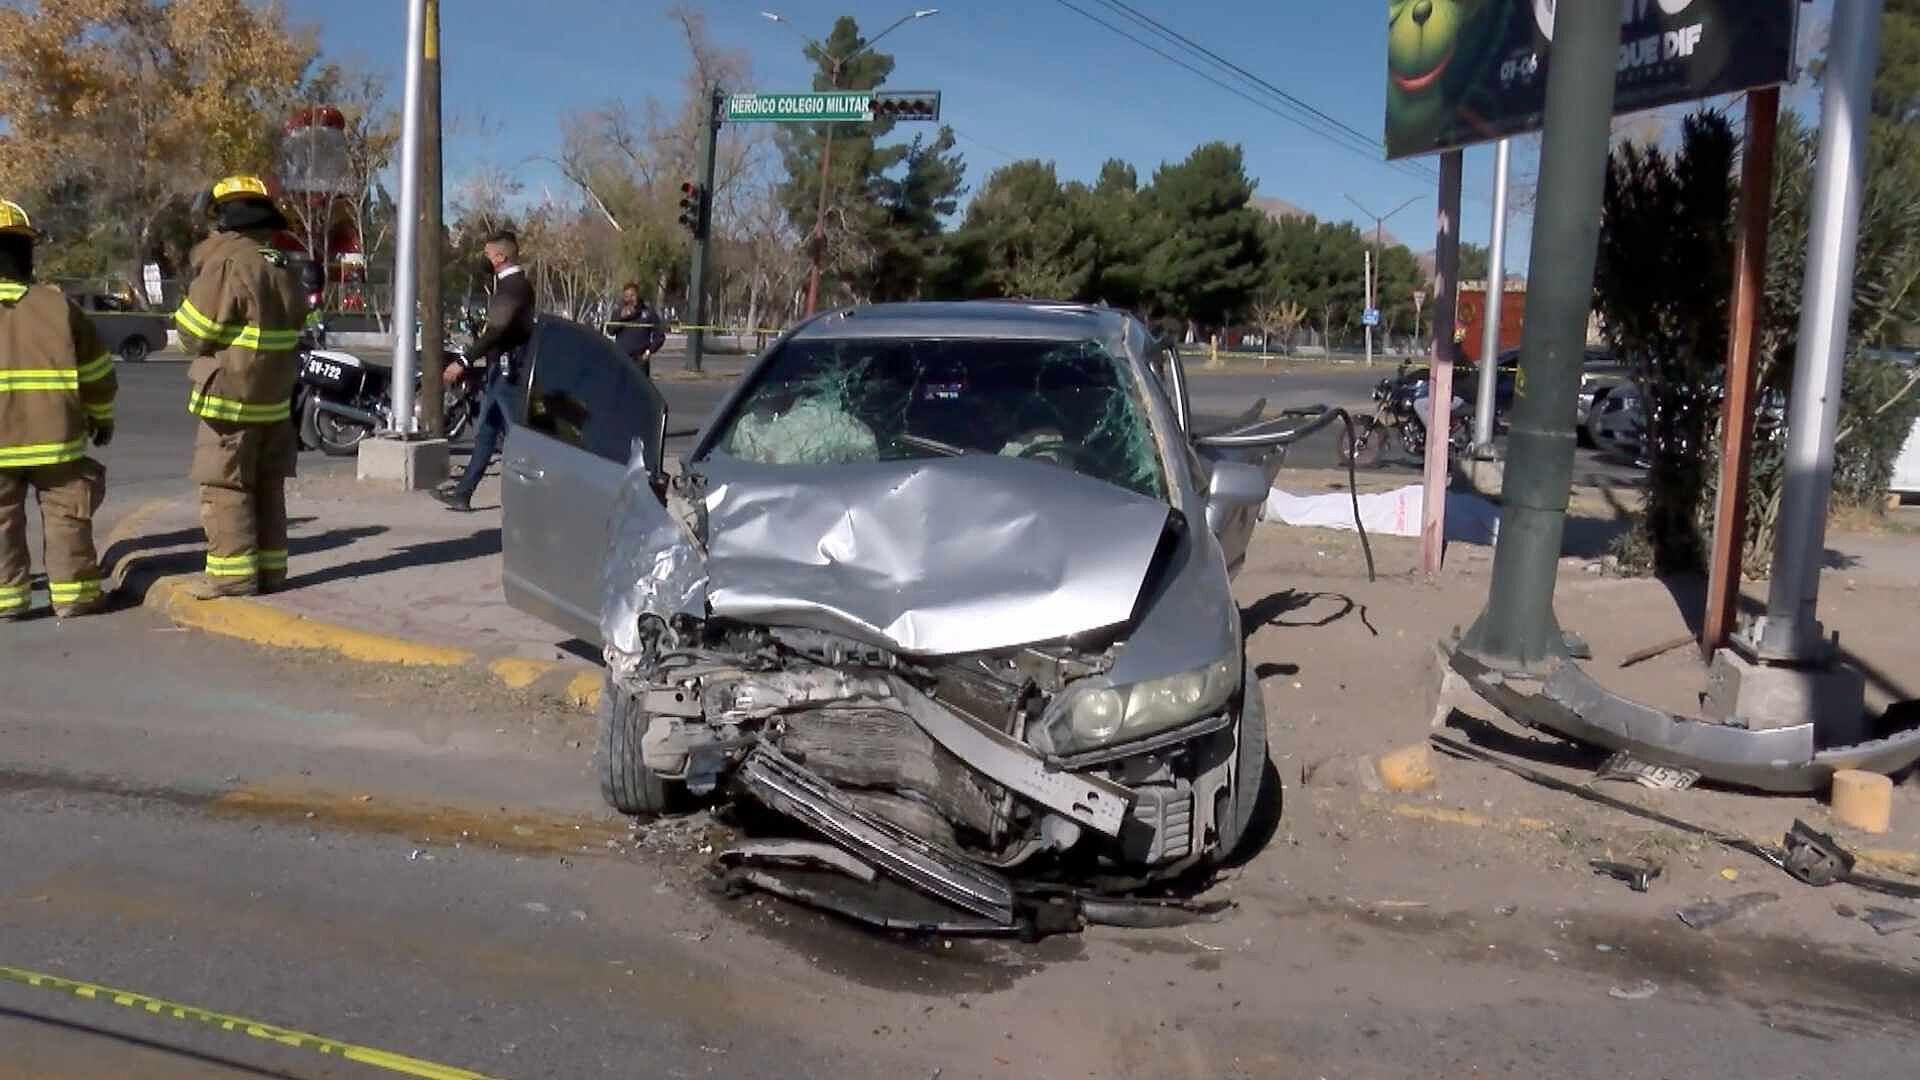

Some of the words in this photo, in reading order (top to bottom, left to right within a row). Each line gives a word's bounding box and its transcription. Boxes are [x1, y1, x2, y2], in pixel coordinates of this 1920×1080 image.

[1664, 23, 1703, 60] DIF
[777, 96, 825, 113] COLEGIO
[826, 96, 870, 113] MILITAR
